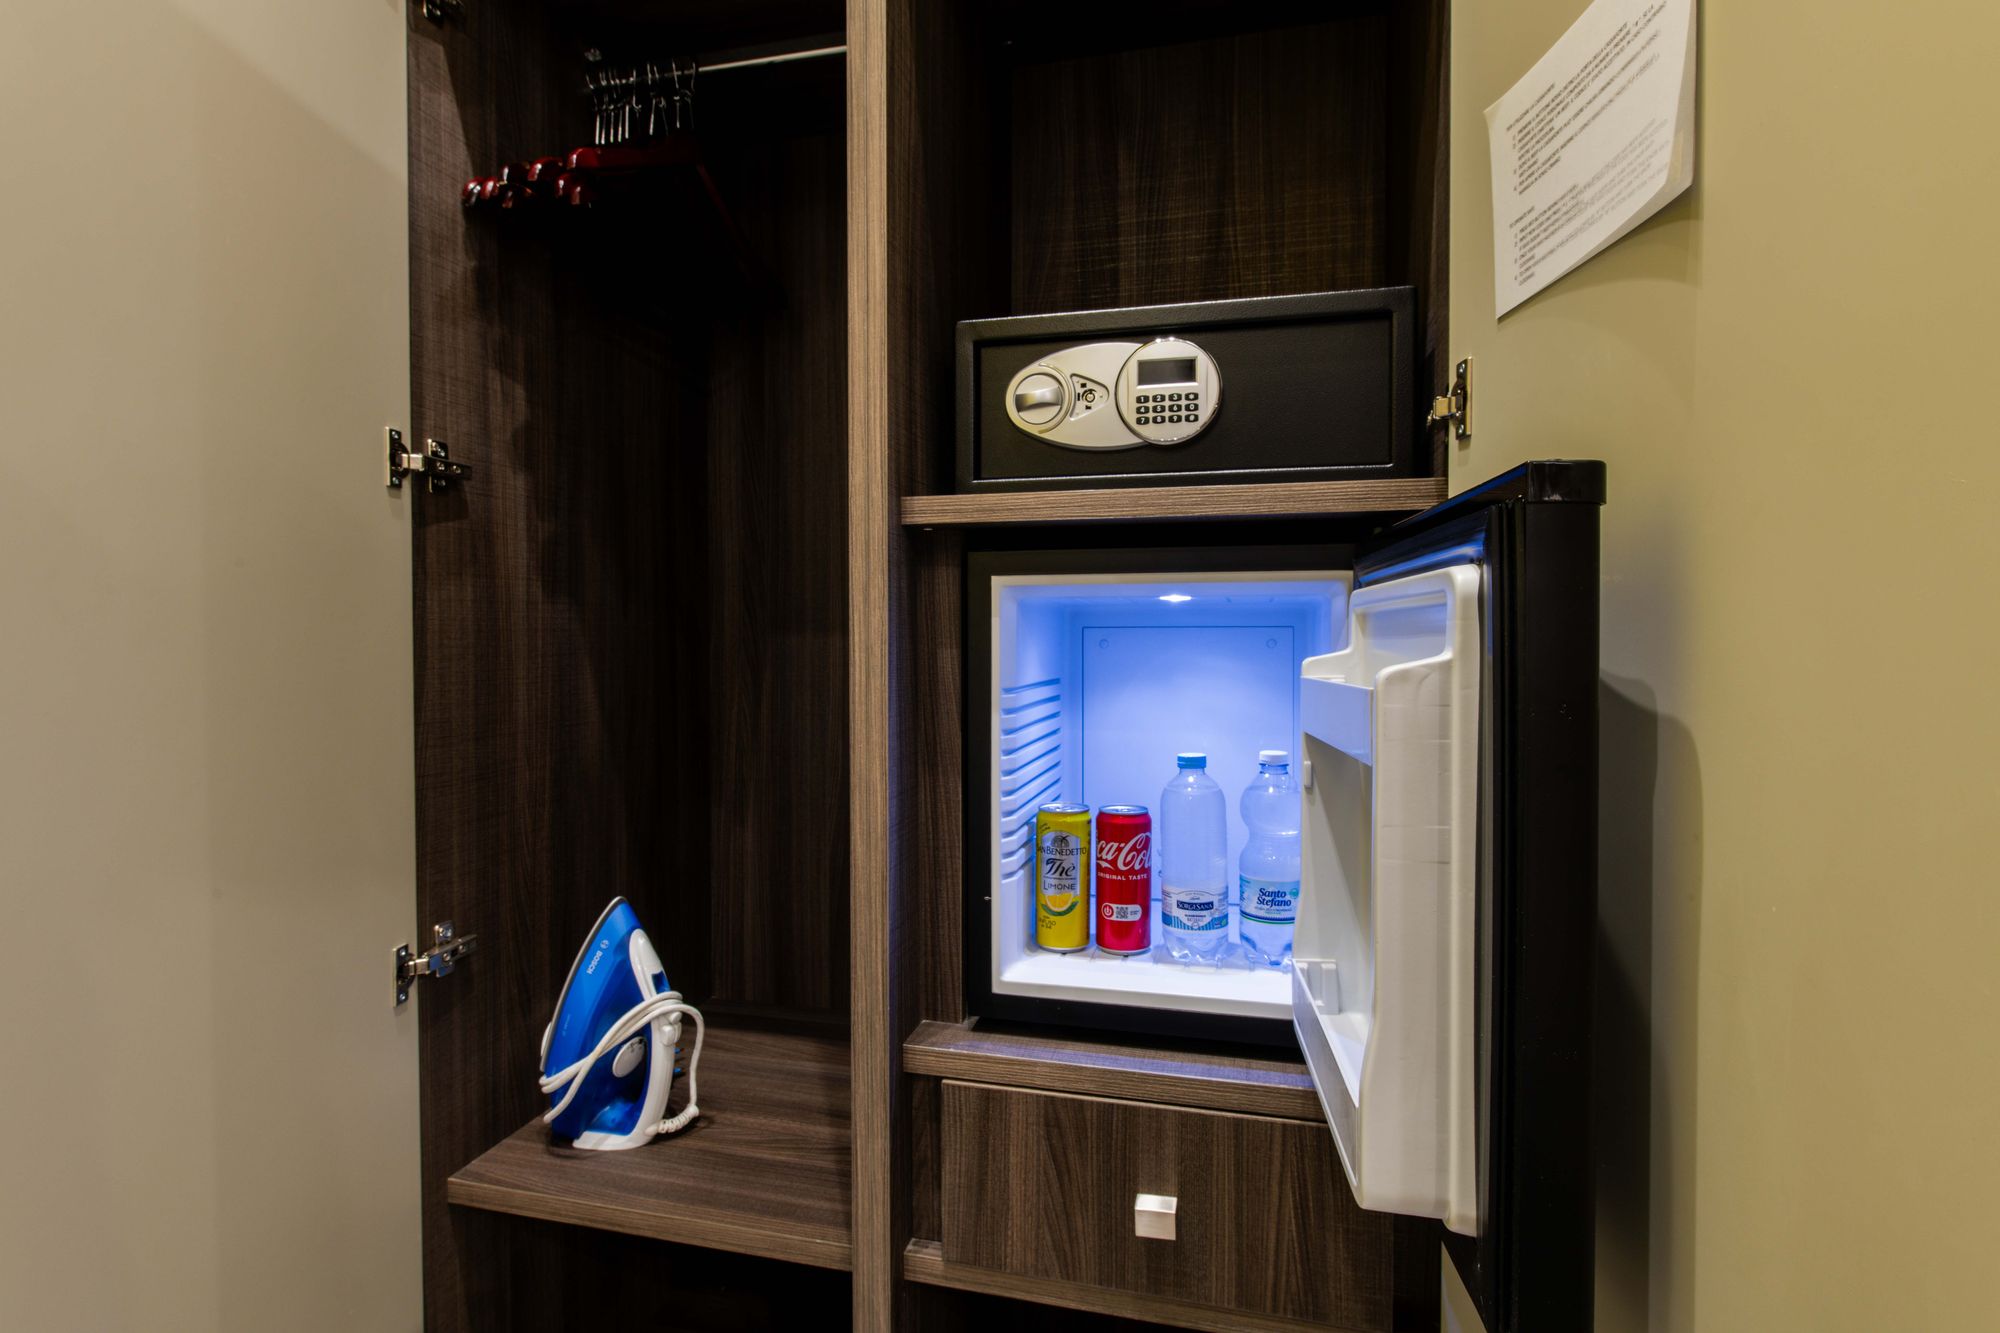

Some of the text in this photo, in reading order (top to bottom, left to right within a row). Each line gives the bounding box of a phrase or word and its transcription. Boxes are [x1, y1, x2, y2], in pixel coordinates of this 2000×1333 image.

[1046, 846, 1088, 856] BENEDETTO
[1096, 832, 1151, 871] ca-Col
[1128, 873, 1148, 881] TASTE
[1043, 879, 1077, 891] LIMONE
[1258, 887, 1287, 898] Santo
[1256, 896, 1292, 908] Stefano
[586, 950, 603, 975] BOSCH
